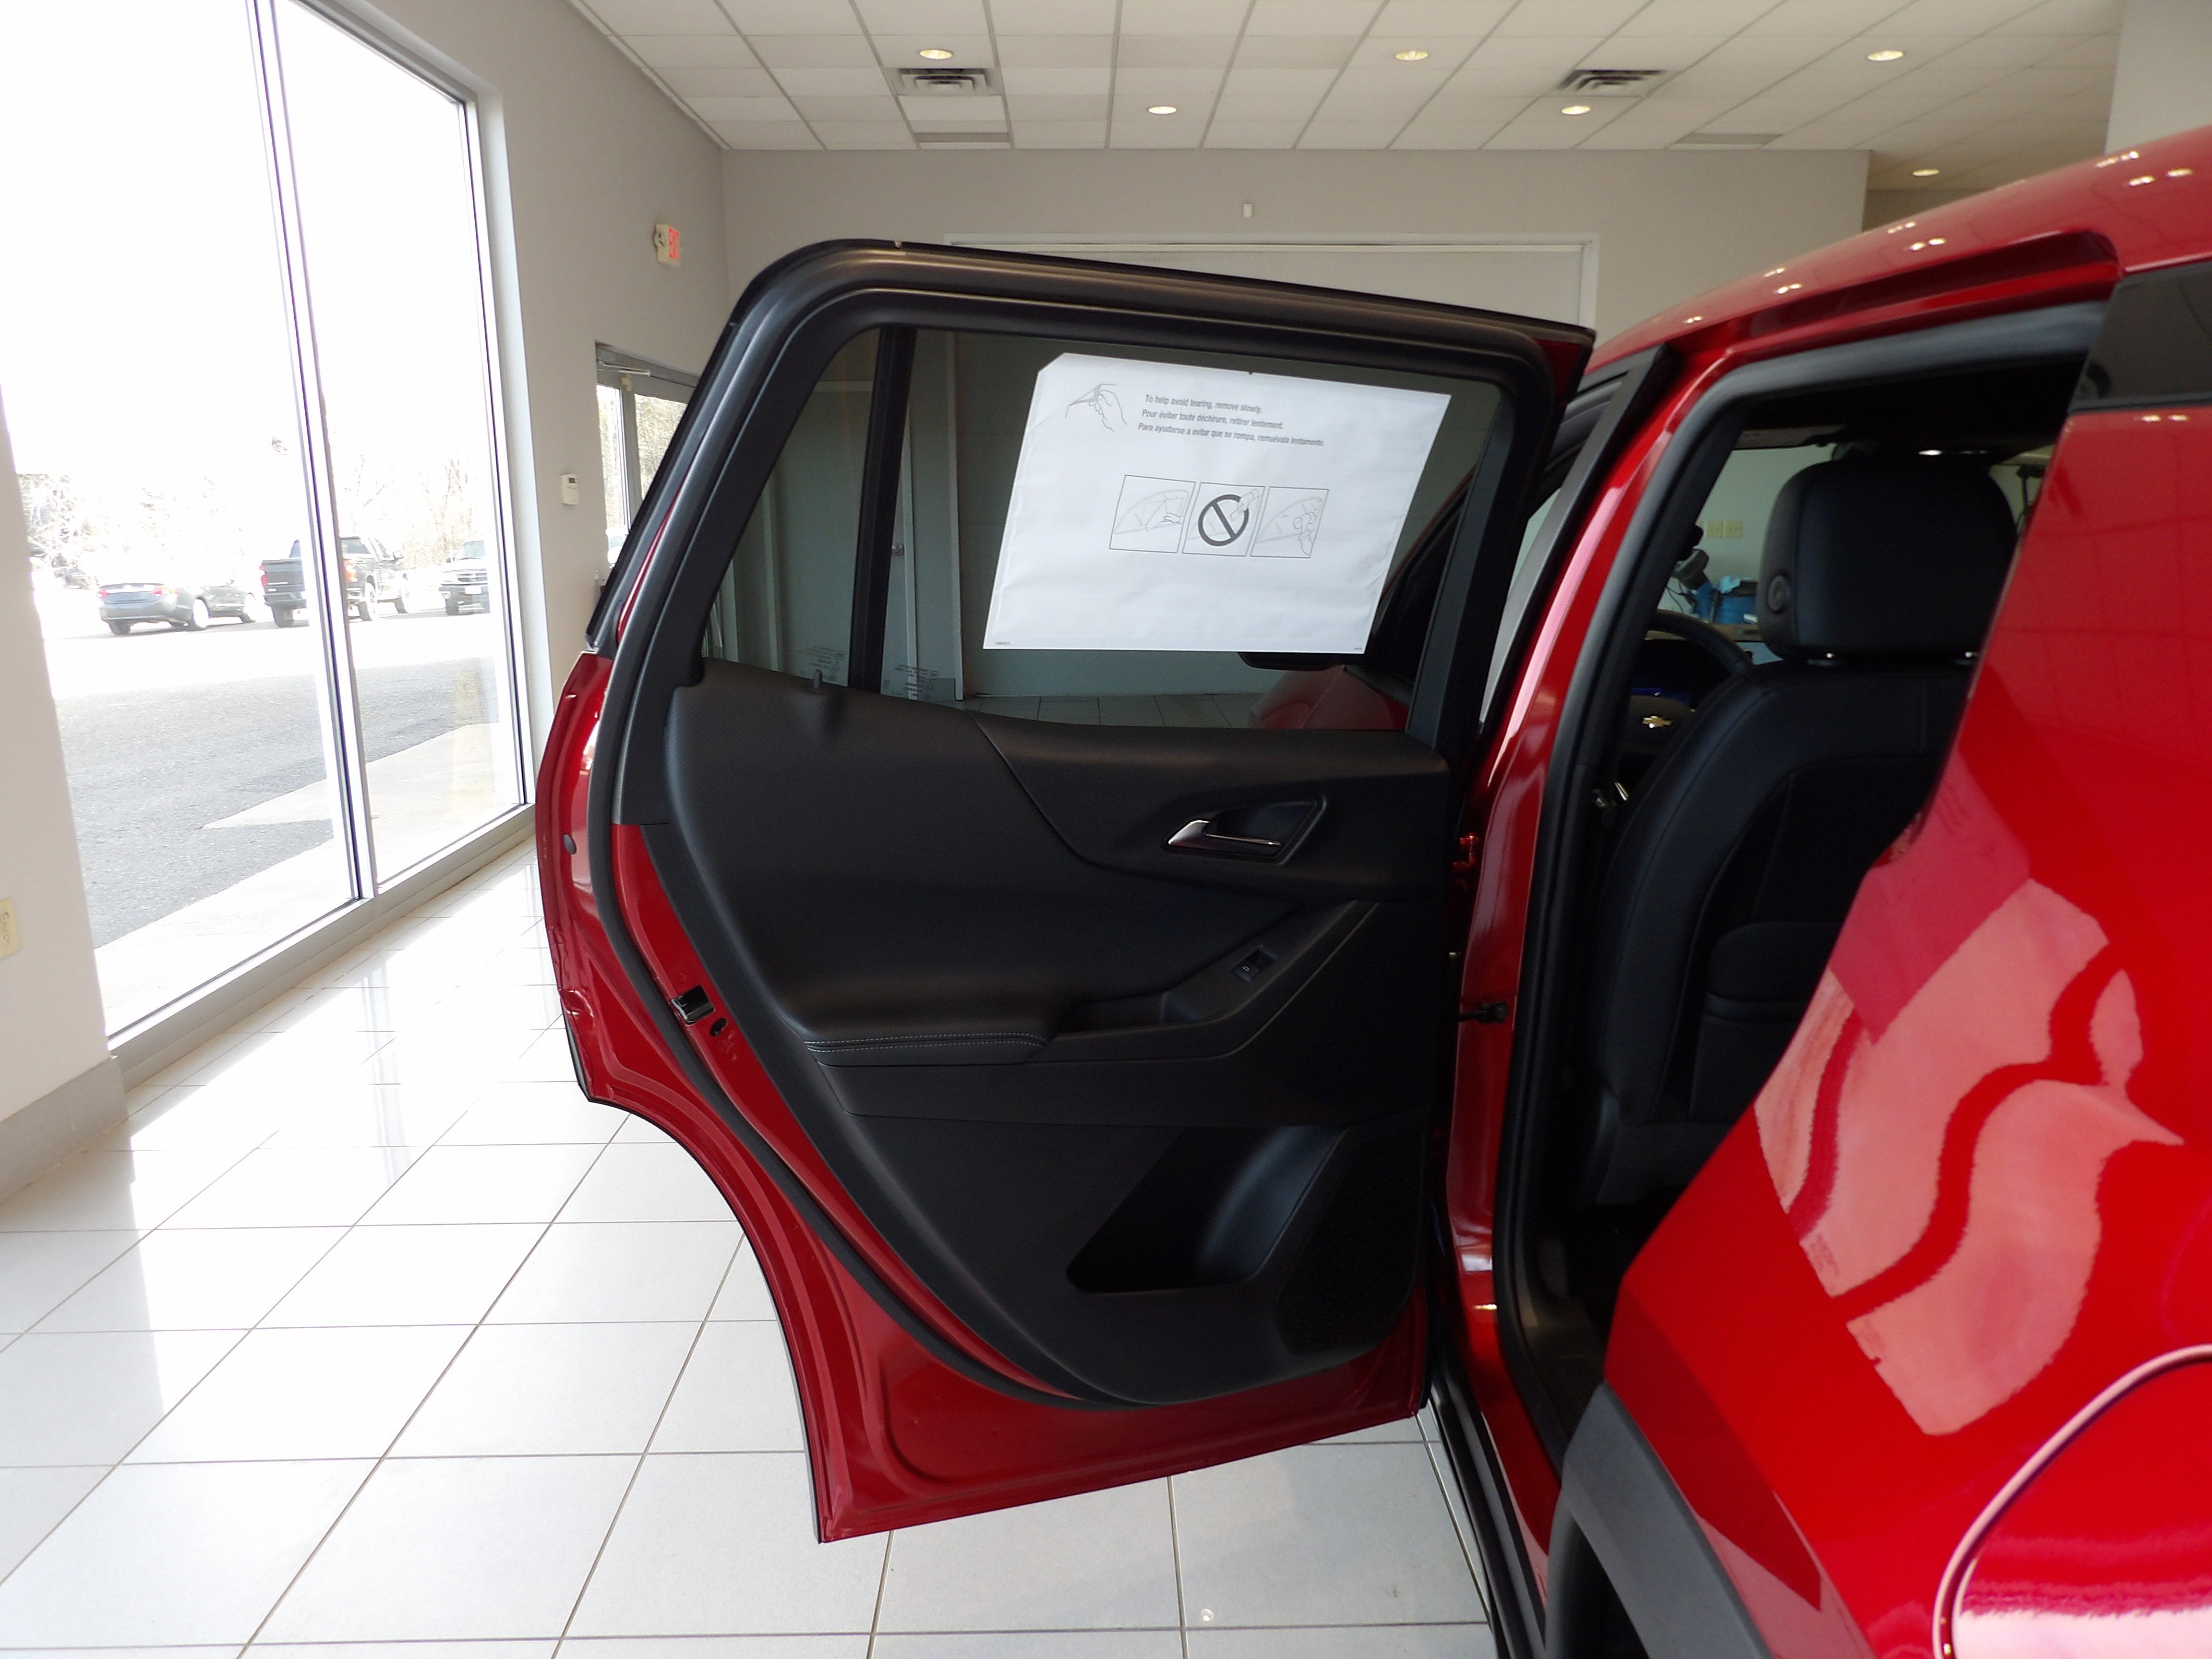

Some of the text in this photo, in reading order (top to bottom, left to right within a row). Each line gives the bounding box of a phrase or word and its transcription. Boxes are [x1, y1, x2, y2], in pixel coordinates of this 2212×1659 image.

[1145, 394, 1262, 414] To help avoid tearing, remove slowly.
[1142, 409, 1157, 418] Pour
[1158, 410, 1178, 420] éviter
[1178, 412, 1195, 421] toute
[1229, 417, 1250, 426] retirer
[1138, 422, 1153, 431] Para
[1154, 425, 1185, 435] ayudarse
[1192, 427, 1210, 436] evitar
[1210, 430, 1223, 438] que
[1224, 431, 1232, 439] se
